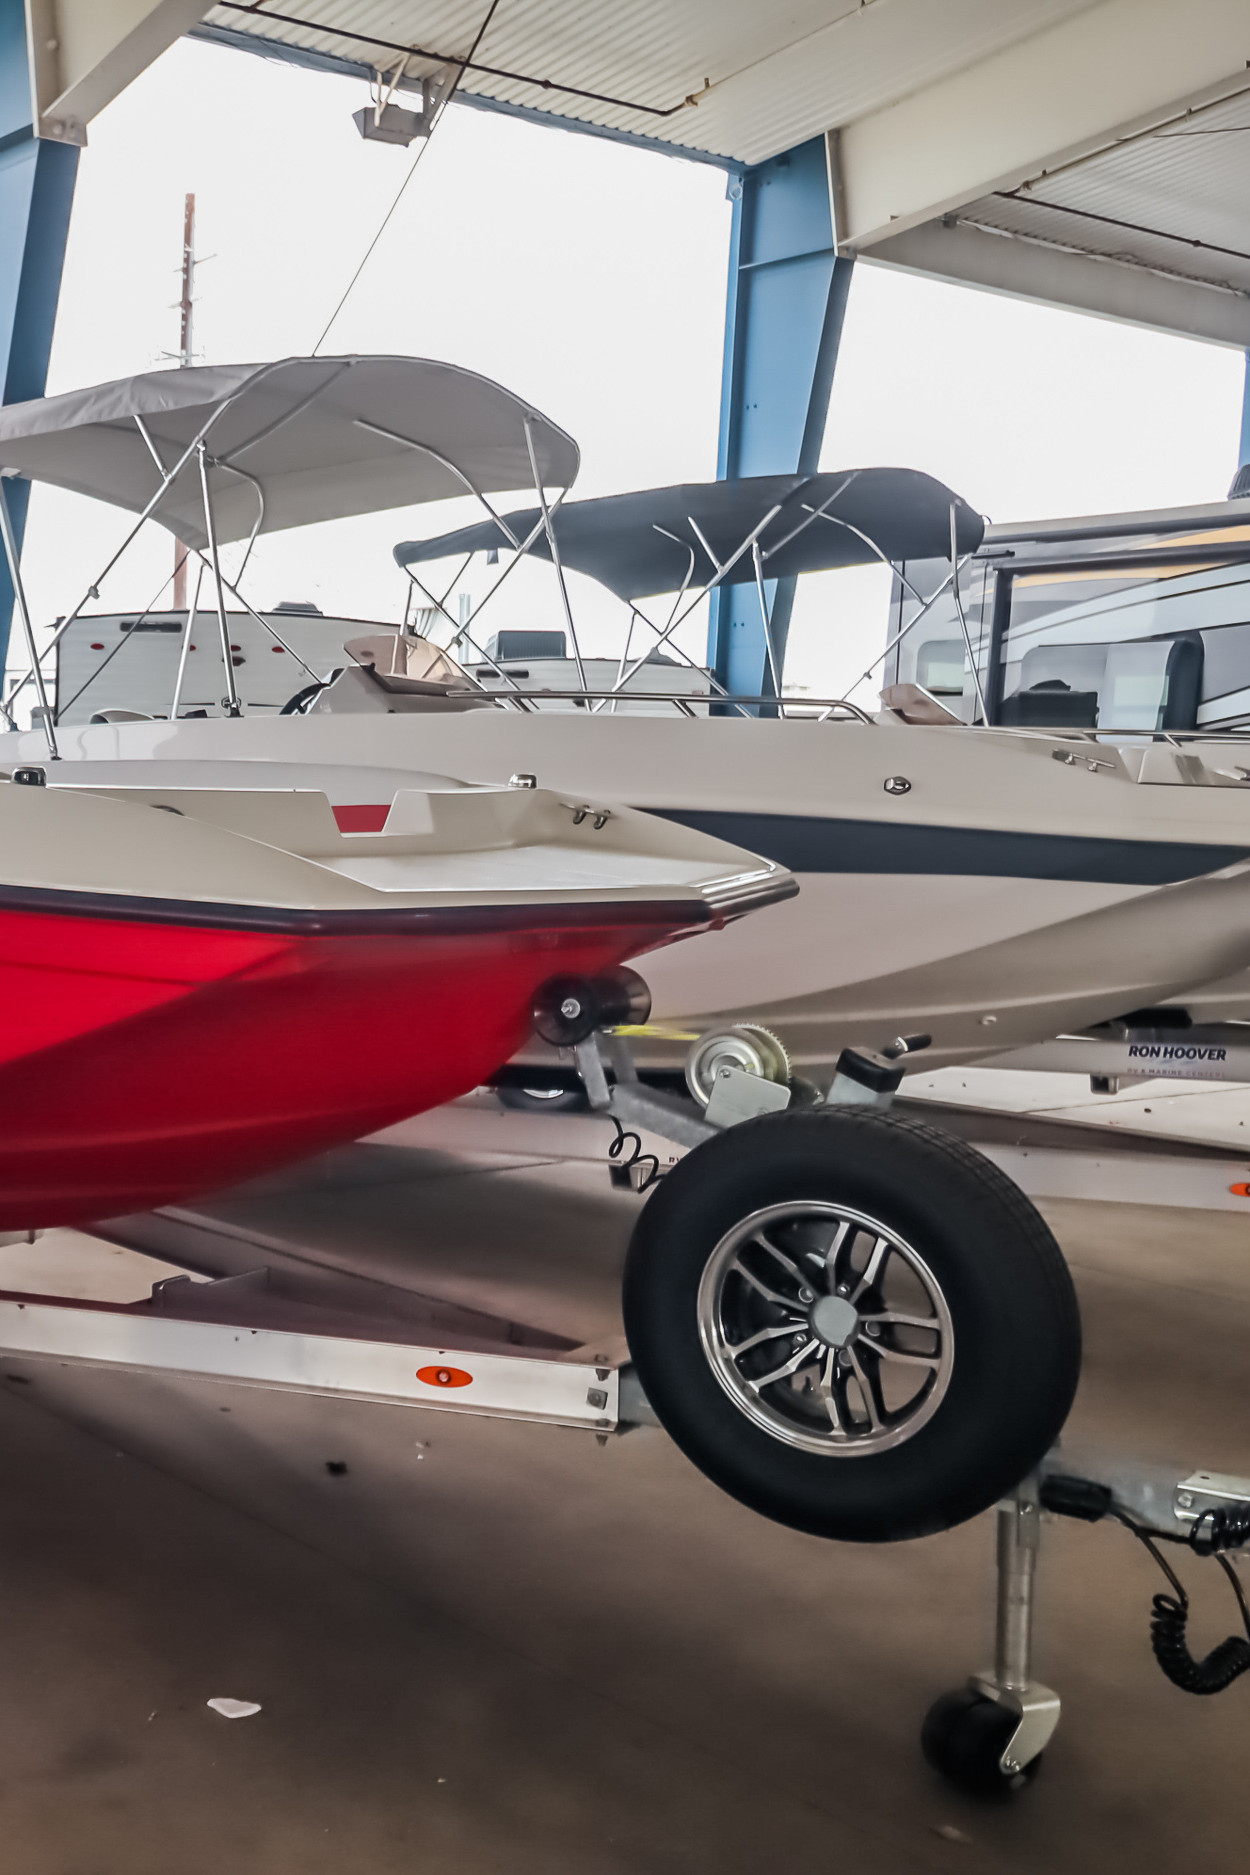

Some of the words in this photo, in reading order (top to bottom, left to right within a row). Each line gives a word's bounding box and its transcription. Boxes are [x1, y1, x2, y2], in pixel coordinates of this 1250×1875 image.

[1128, 1045, 1161, 1058] RON
[1162, 1046, 1227, 1061] HOOVER
[1186, 1069, 1226, 1078] CENTERS
